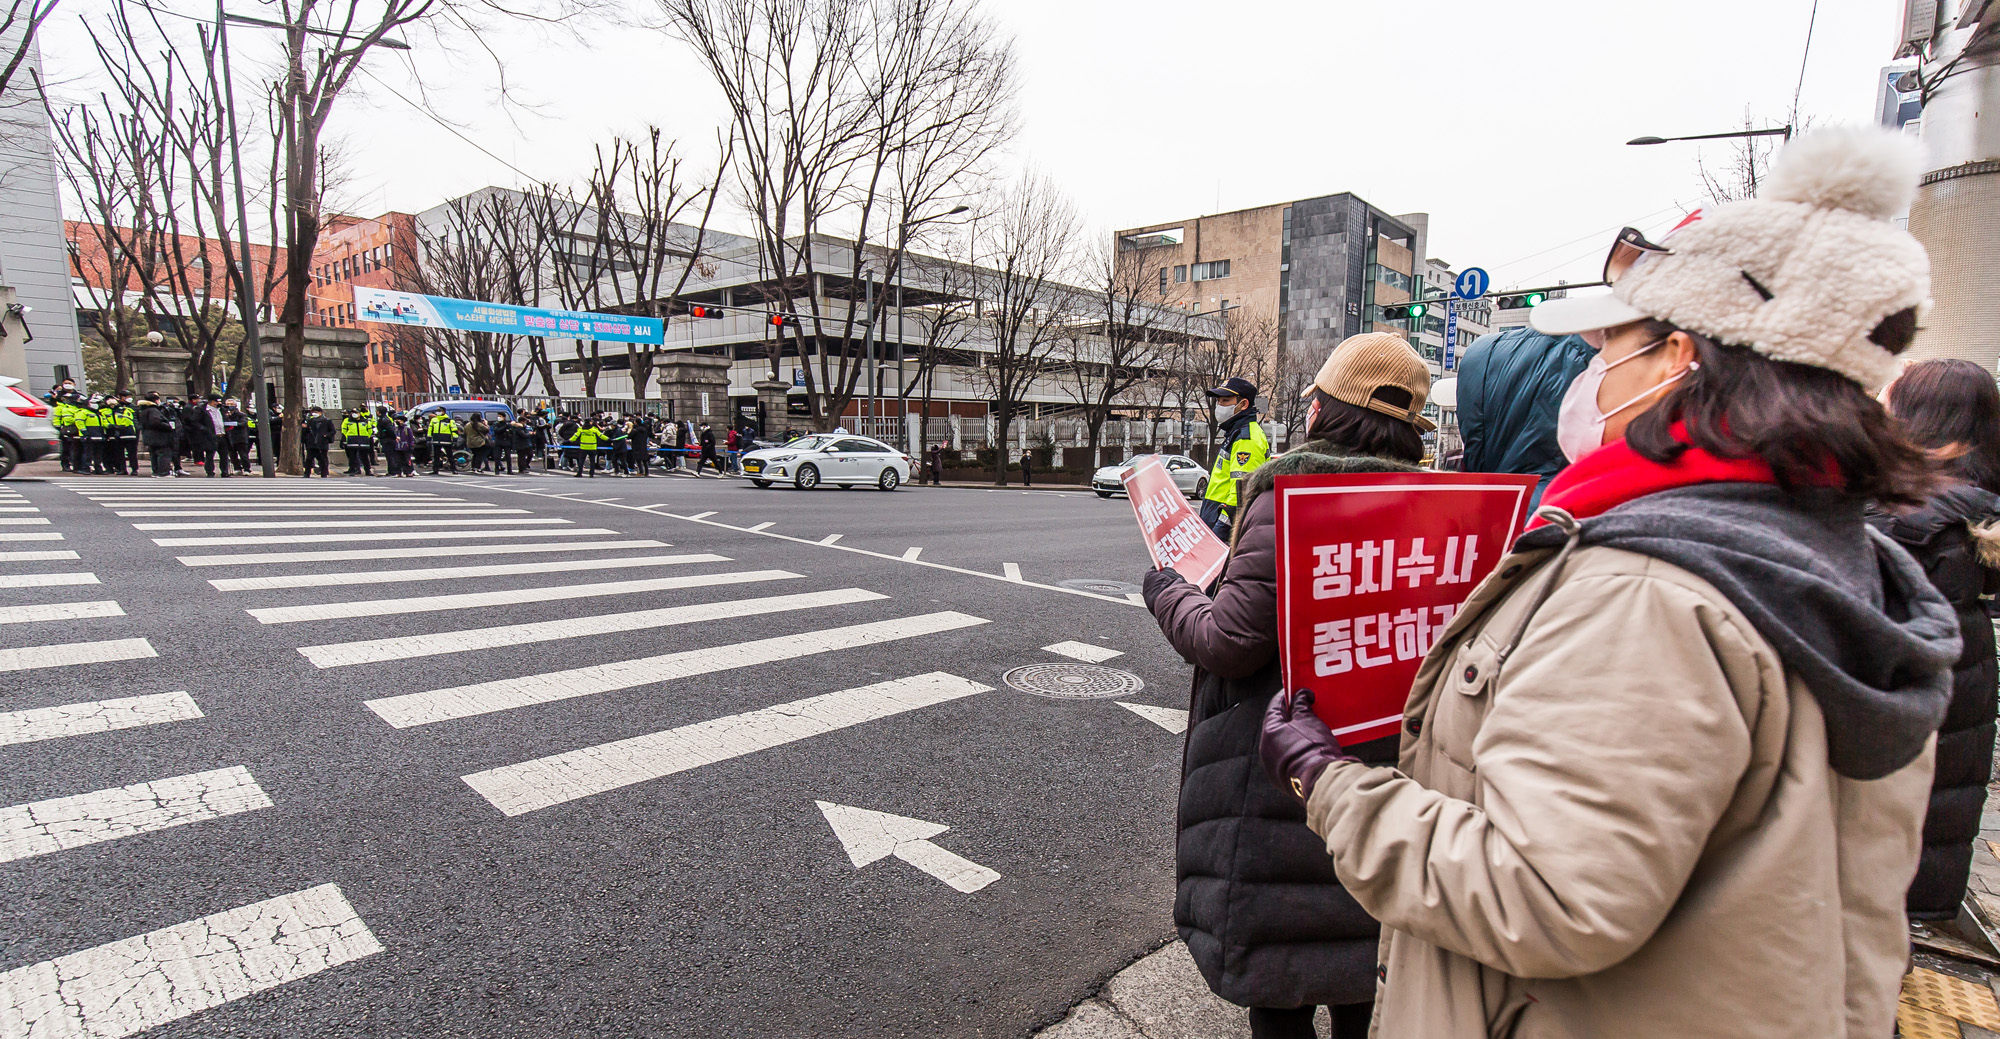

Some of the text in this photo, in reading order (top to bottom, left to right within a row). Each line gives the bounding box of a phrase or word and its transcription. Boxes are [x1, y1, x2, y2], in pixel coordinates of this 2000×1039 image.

[473, 306, 517, 318] 서울회생법원
[1456, 301, 1487, 310] 보행신호시
[456, 312, 517, 326] 뉴스타트 상담센터
[524, 315, 651, 336] 맞춤형 상담 및 전화상담 실시
[1138, 487, 1180, 535] 정치수사
[1154, 516, 1206, 567] 중단하라!
[1313, 534, 1479, 601] 정치수사
